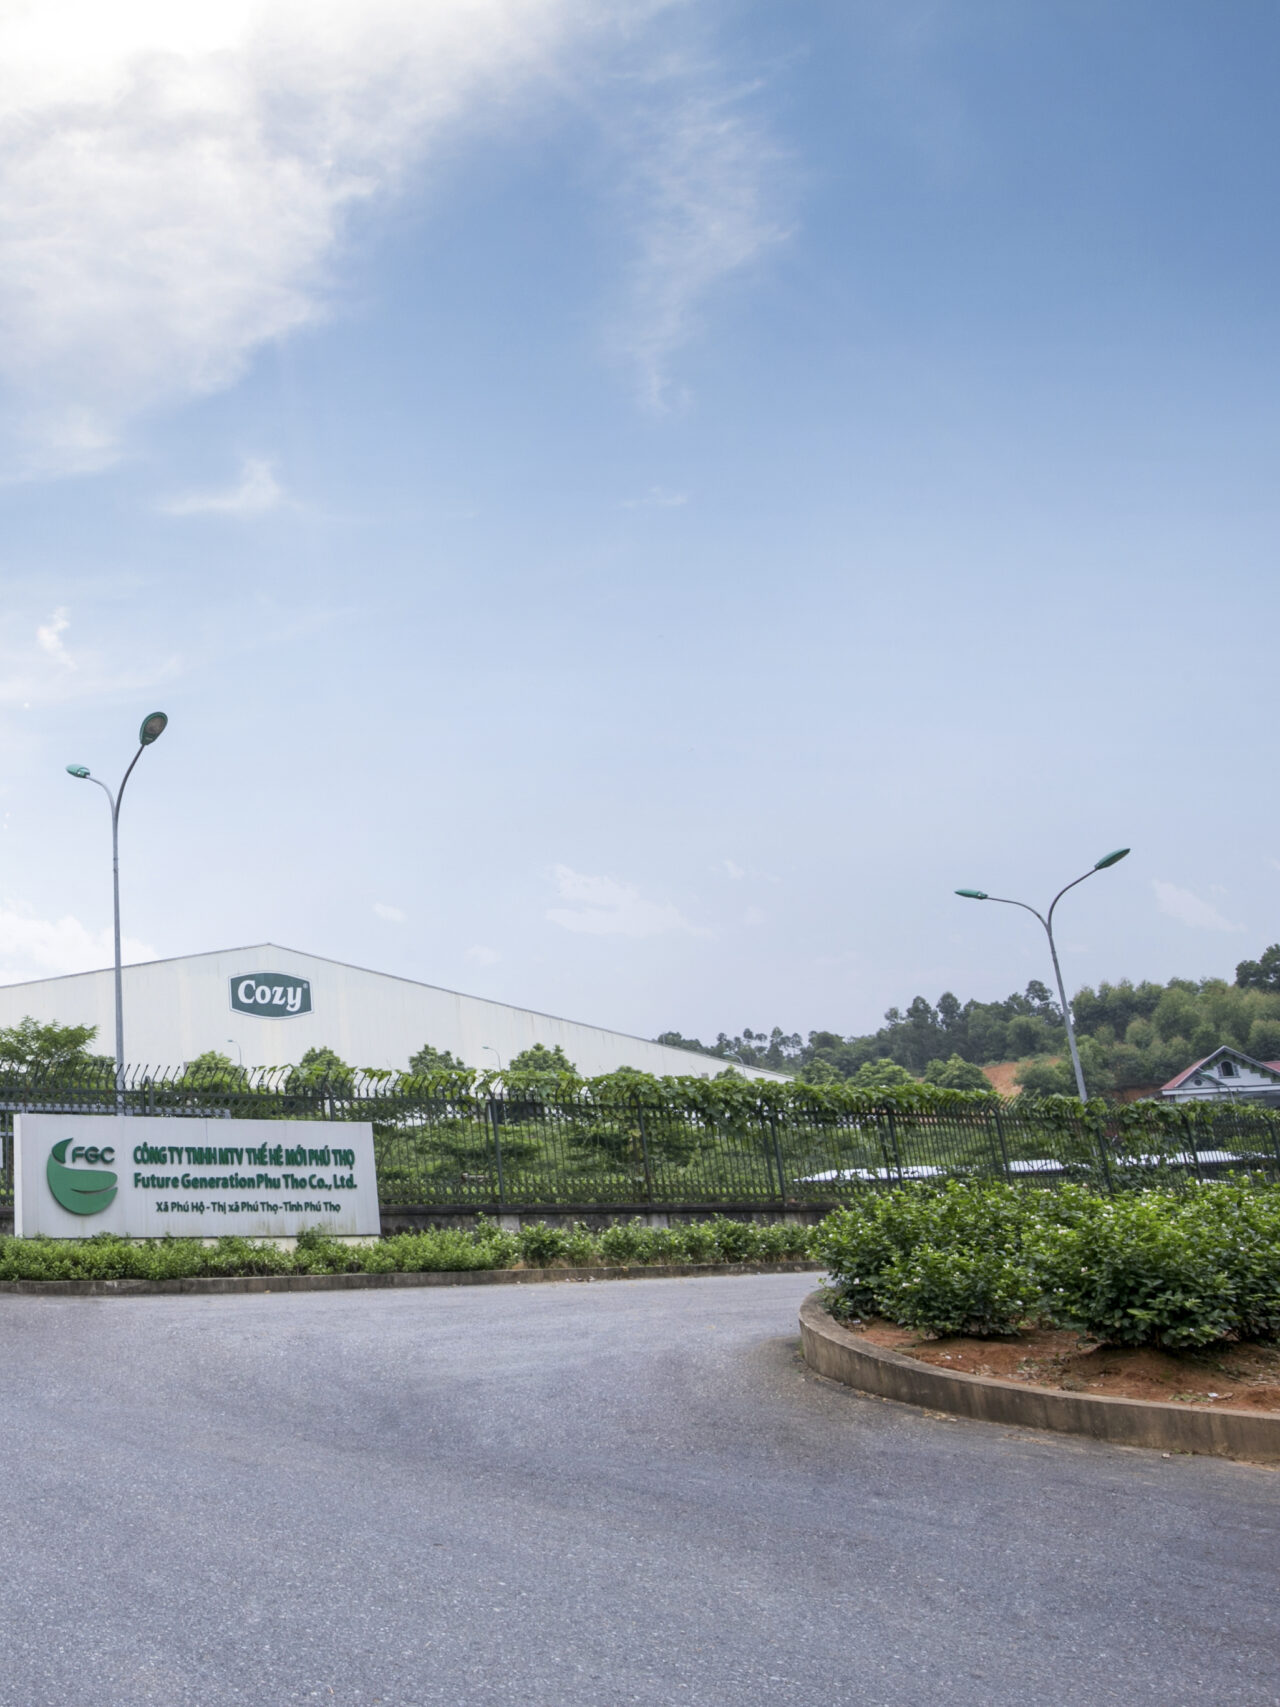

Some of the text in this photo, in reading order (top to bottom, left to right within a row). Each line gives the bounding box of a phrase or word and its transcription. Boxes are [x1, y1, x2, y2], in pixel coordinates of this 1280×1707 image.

[237, 979, 302, 1012] Cozy
[71, 1146, 115, 1164] FGC
[133, 1141, 168, 1165] CÔNG
[168, 1146, 183, 1165] TY
[331, 1148, 355, 1171] THỌ
[133, 1172, 180, 1189] Future
[181, 1172, 255, 1190] Generation
[256, 1173, 281, 1189] Phu
[282, 1173, 308, 1190] Tho
[333, 1173, 358, 1190] Ltd.
[170, 1200, 189, 1212] Phú
[241, 1201, 259, 1212] Phú
[304, 1201, 322, 1213] Phú
